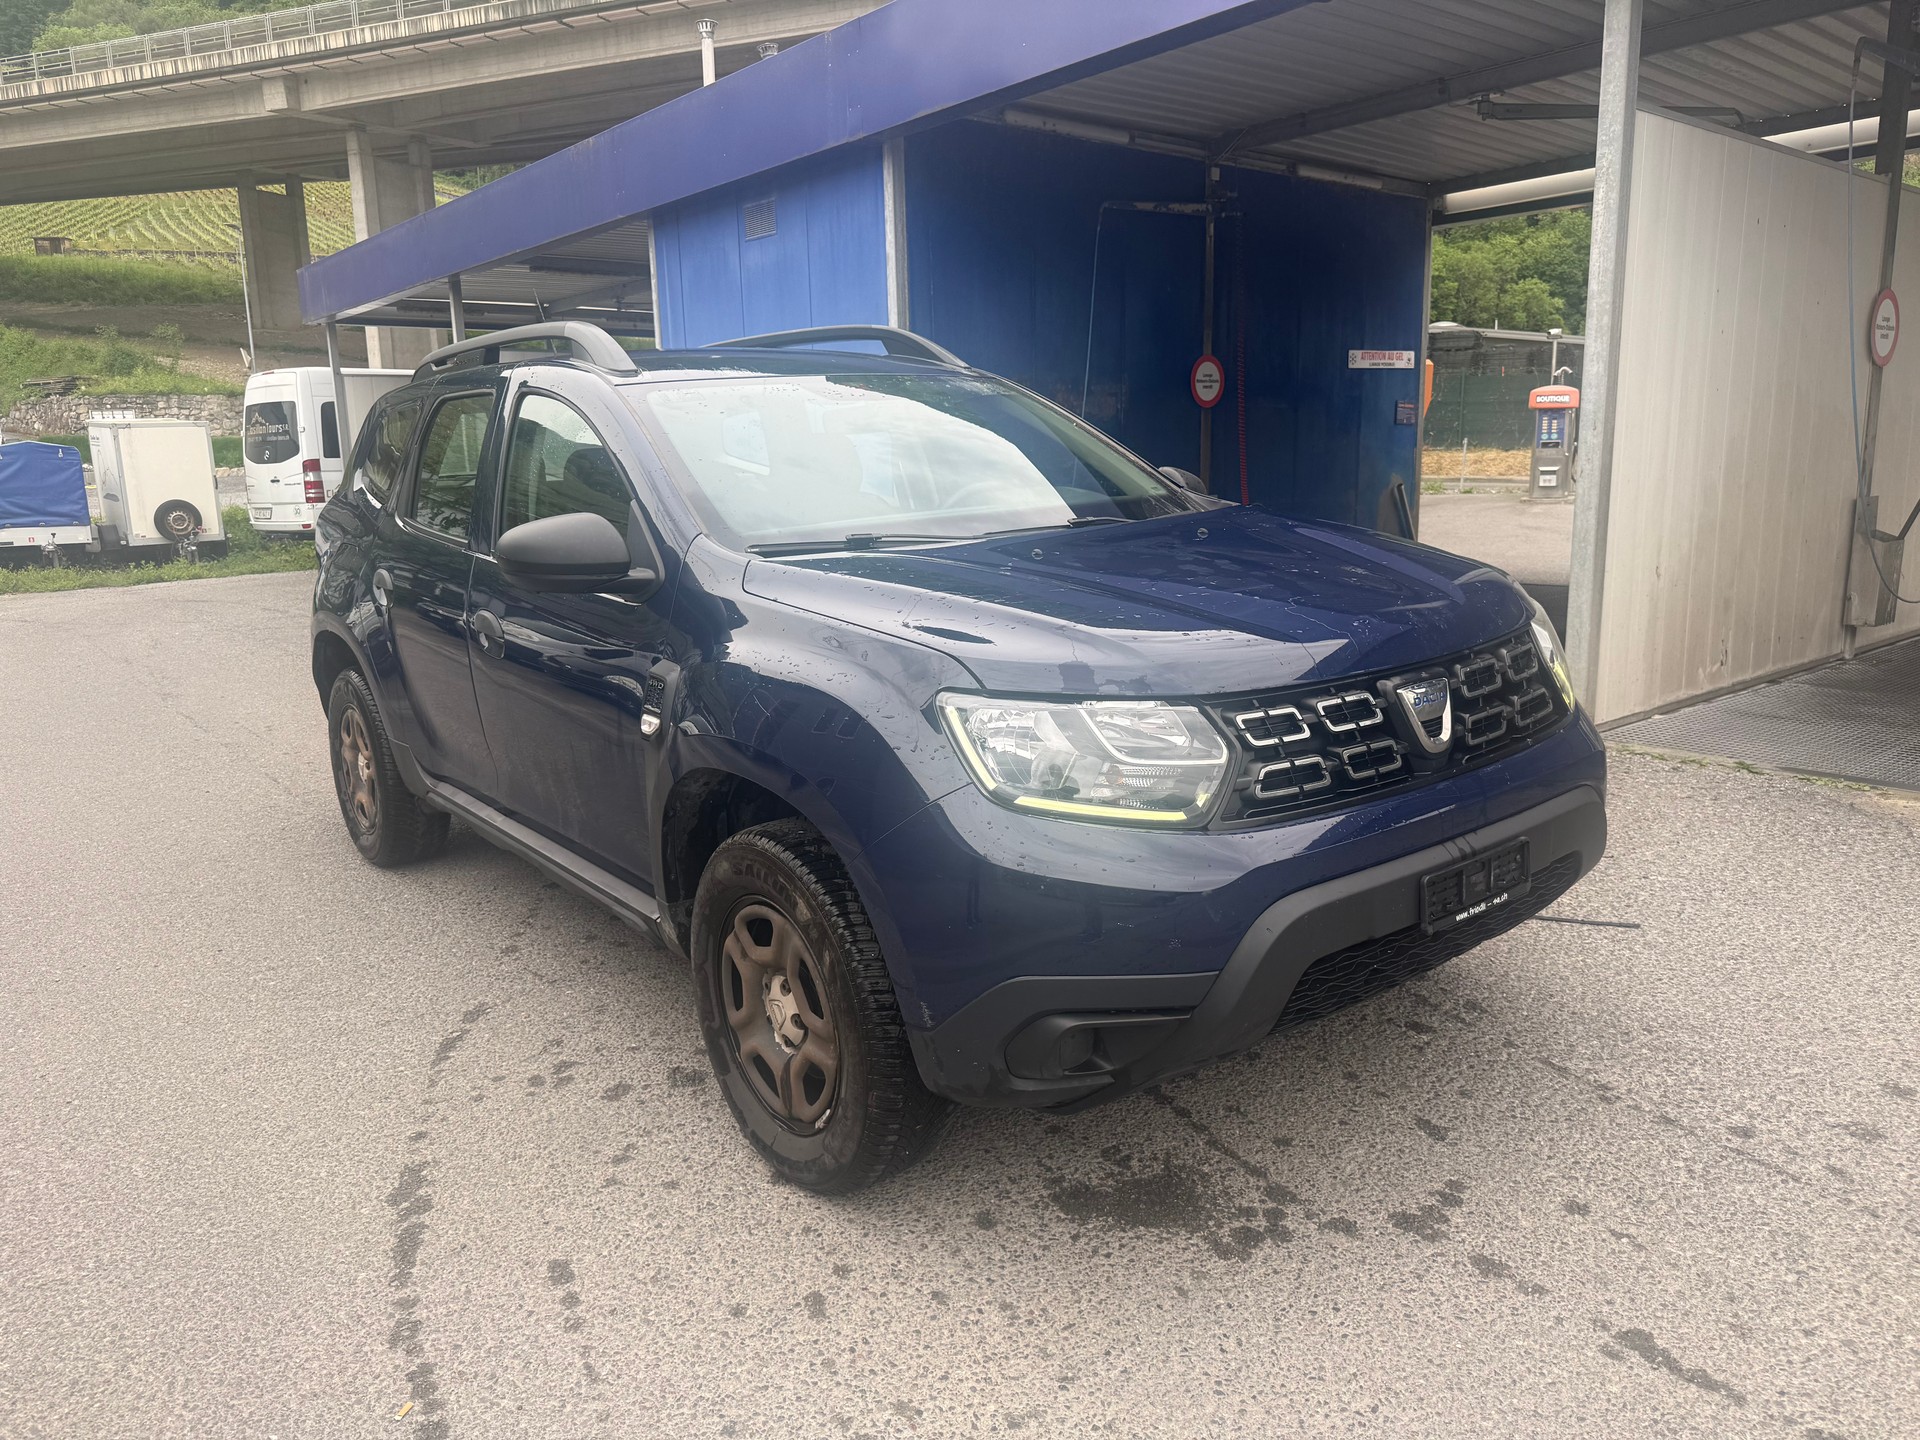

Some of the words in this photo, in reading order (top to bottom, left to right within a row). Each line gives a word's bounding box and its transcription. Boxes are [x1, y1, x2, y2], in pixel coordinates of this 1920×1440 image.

[1360, 351, 1386, 361] ATTENTION
[1387, 352, 1395, 361] AU
[1395, 352, 1404, 361] GEL
[1536, 394, 1571, 403] BOUTIQUE
[1413, 690, 1446, 708] DACIA
